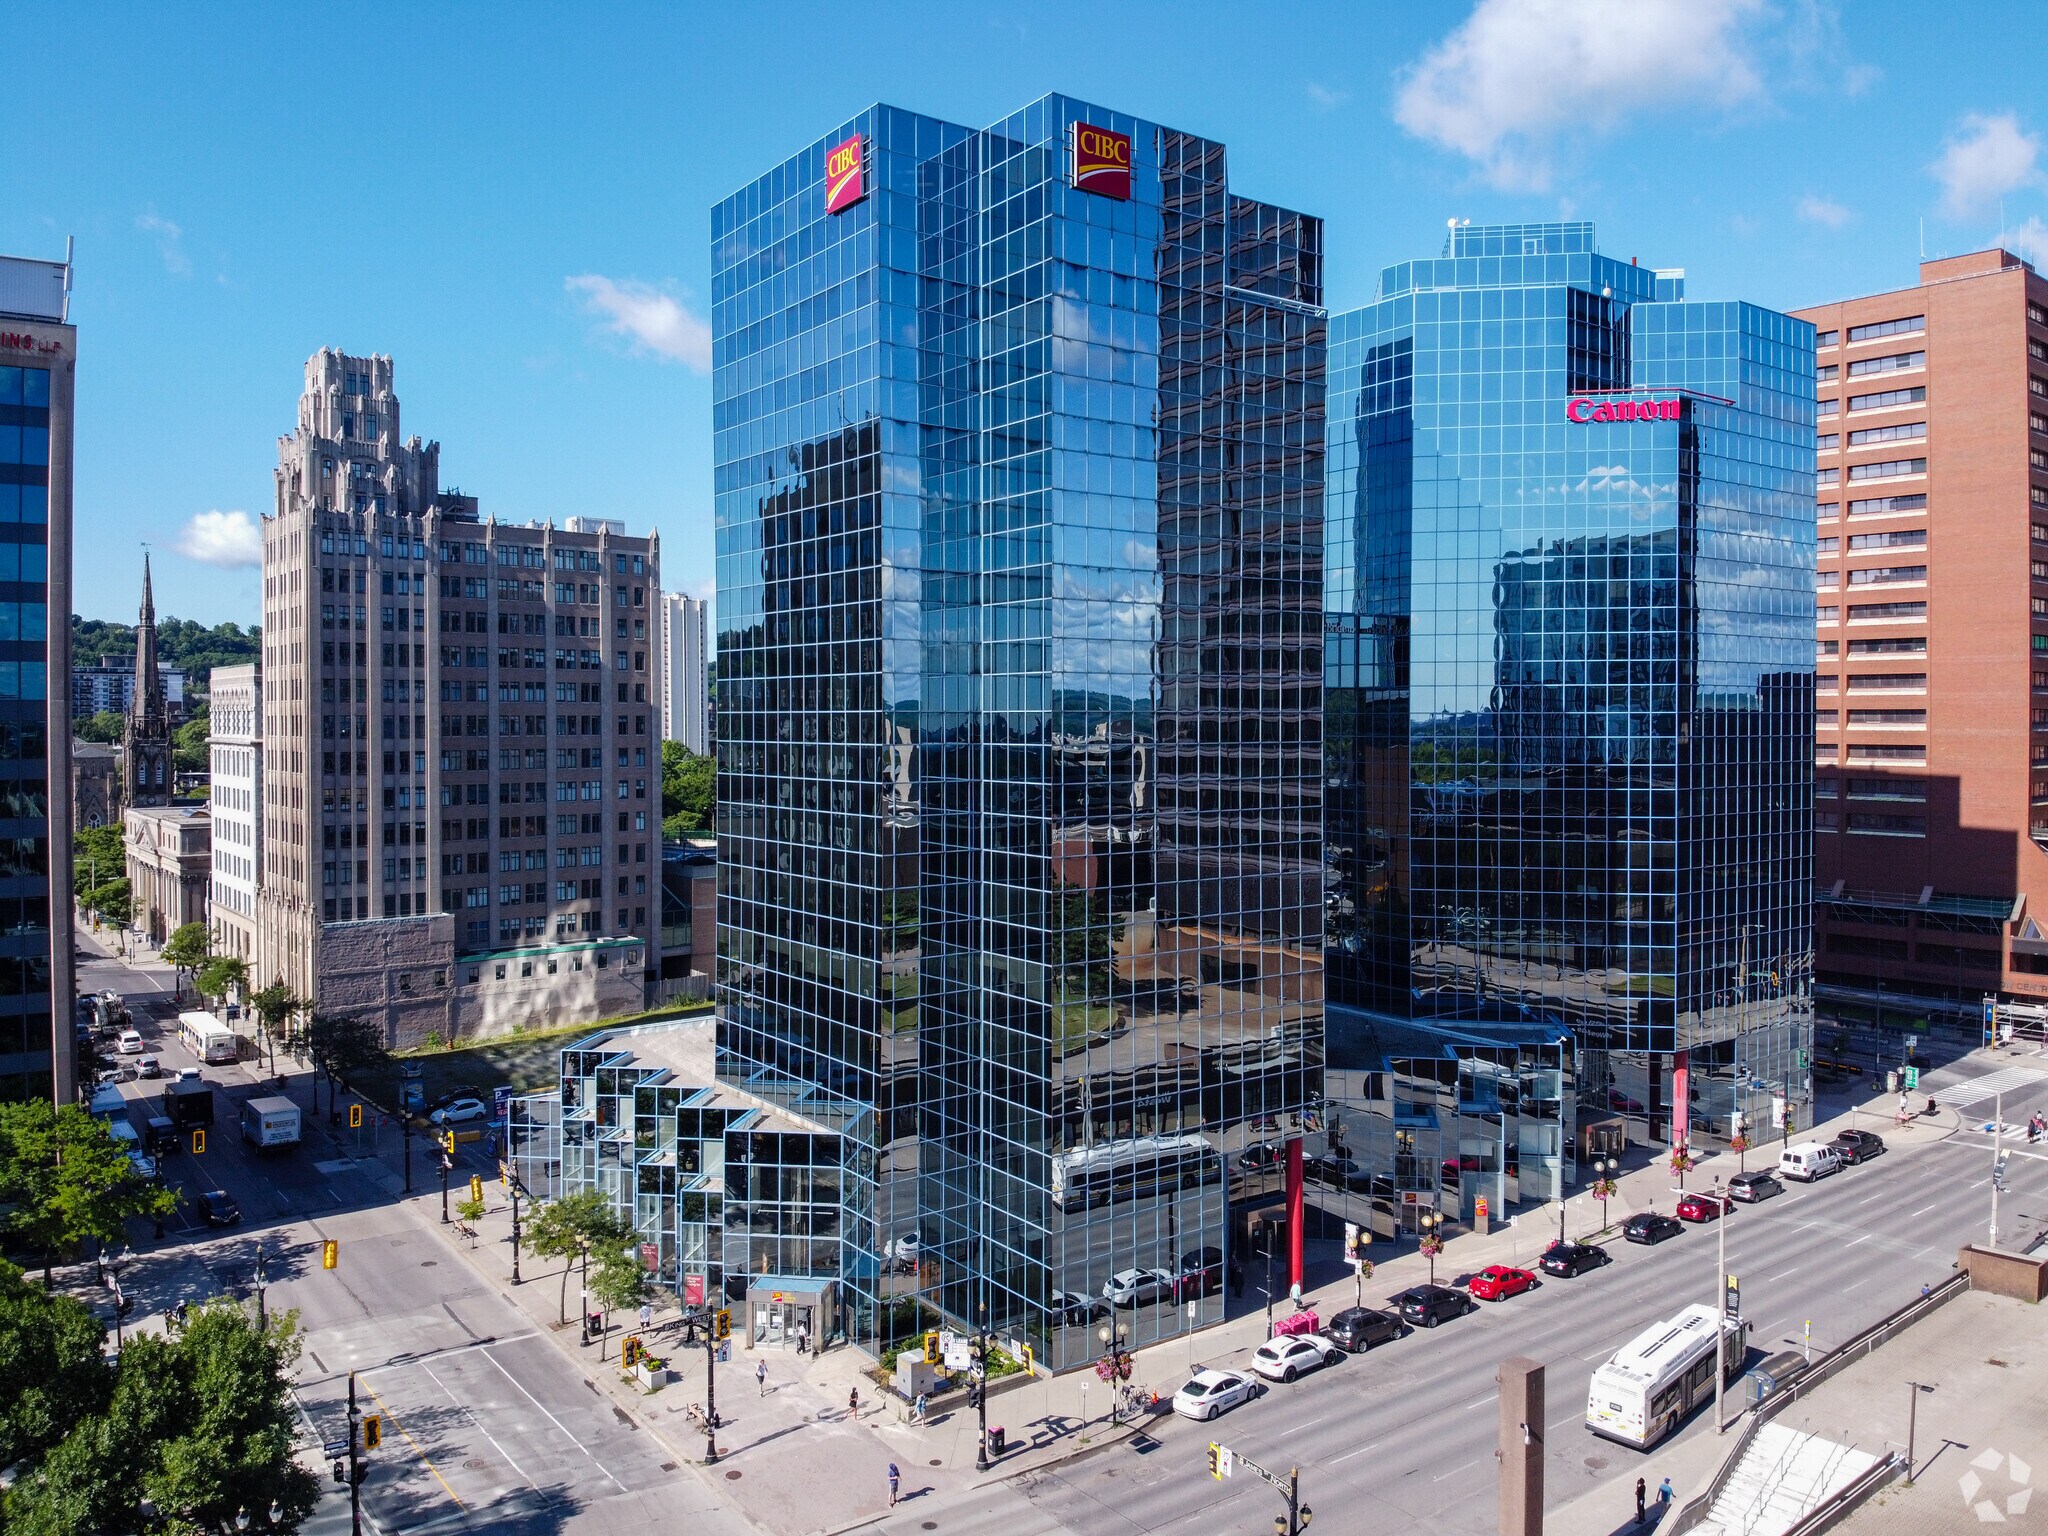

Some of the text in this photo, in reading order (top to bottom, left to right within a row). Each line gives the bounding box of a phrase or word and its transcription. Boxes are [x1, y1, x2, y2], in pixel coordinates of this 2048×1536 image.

[828, 141, 859, 177] CIBC
[1080, 131, 1127, 163] CIBC
[38, 340, 62, 353] LLP
[1566, 398, 1680, 423] Canon
[669, 1320, 685, 1329] KING
[691, 1314, 710, 1323] WEST
[1244, 1459, 1263, 1476] JAMES
[1270, 1475, 1291, 1493] NORTH
